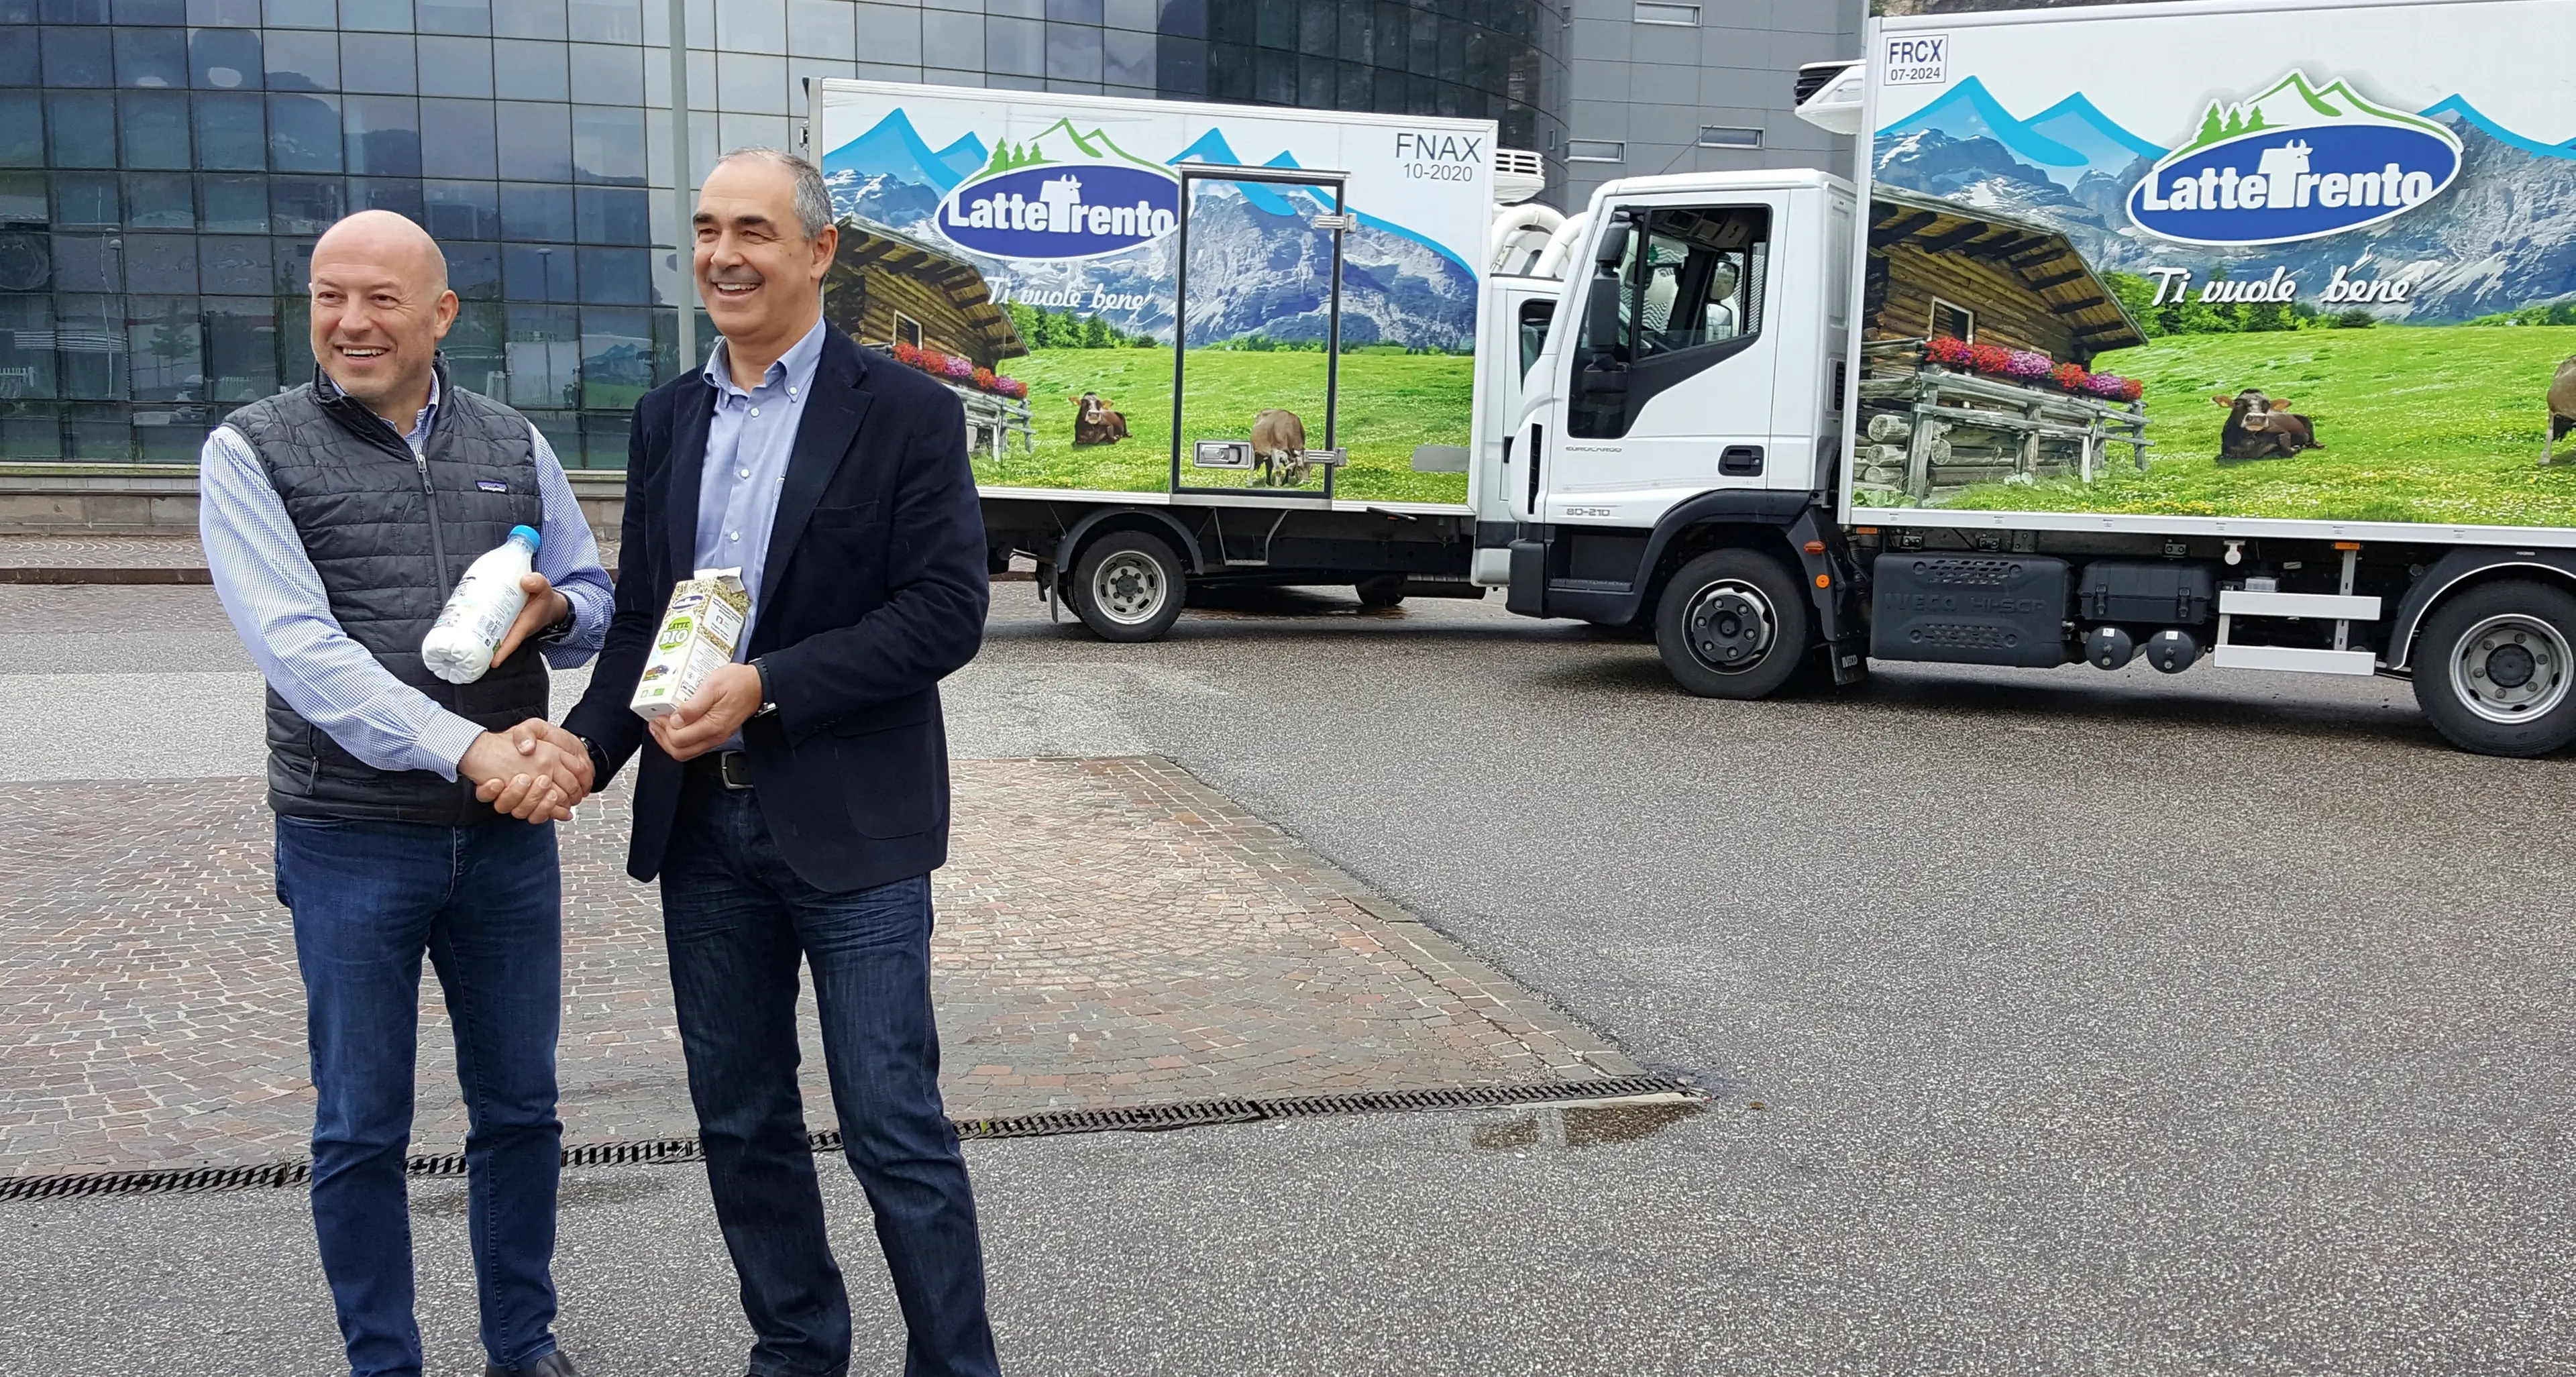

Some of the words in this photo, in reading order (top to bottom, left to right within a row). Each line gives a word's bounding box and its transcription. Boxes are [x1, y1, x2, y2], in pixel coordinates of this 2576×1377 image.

[1888, 39, 1943, 64] FRCX
[1890, 67, 1941, 81] 07-2024
[1395, 133, 1482, 163] FNAX
[1403, 163, 1473, 182] 10-2020
[983, 276, 1010, 305] Ti
[1018, 284, 1081, 308] vuole
[1088, 283, 1146, 311] bene
[2147, 267, 2191, 306] Ti
[2198, 266, 2296, 303] vuole
[2322, 266, 2410, 303] bene
[1566, 508, 1611, 516] 80-210
[667, 621, 690, 630] LATTE
[659, 628, 689, 647] BIO
